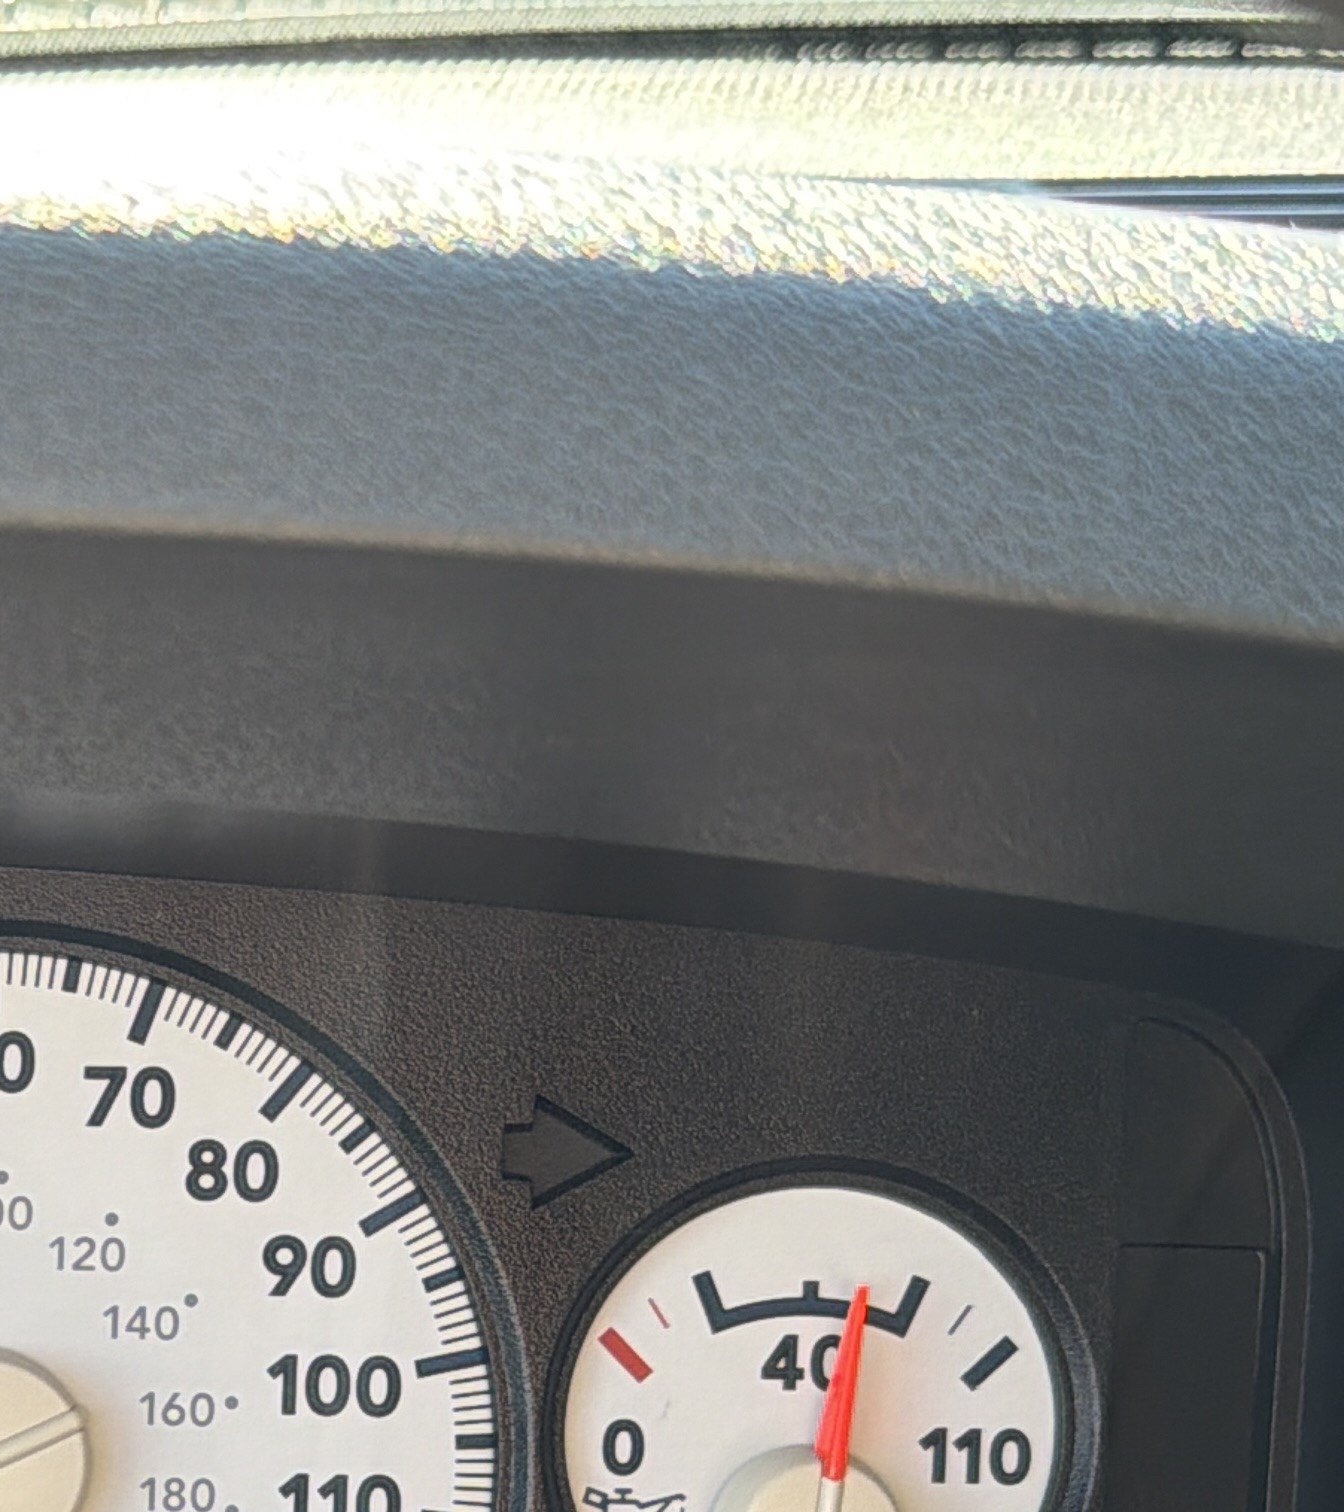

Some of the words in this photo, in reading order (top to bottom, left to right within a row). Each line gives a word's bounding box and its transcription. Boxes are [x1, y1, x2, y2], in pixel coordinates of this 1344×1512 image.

[84, 1066, 175, 1128] 70
[185, 1139, 279, 1203] 80
[48, 1236, 126, 1272] 120
[262, 1234, 356, 1298] 90
[102, 1305, 179, 1340] 140
[140, 1392, 215, 1428] 160
[266, 1354, 402, 1418] 100
[602, 1418, 645, 1476] 0
[919, 1428, 1031, 1485] 110
[140, 1478, 215, 1512] 180
